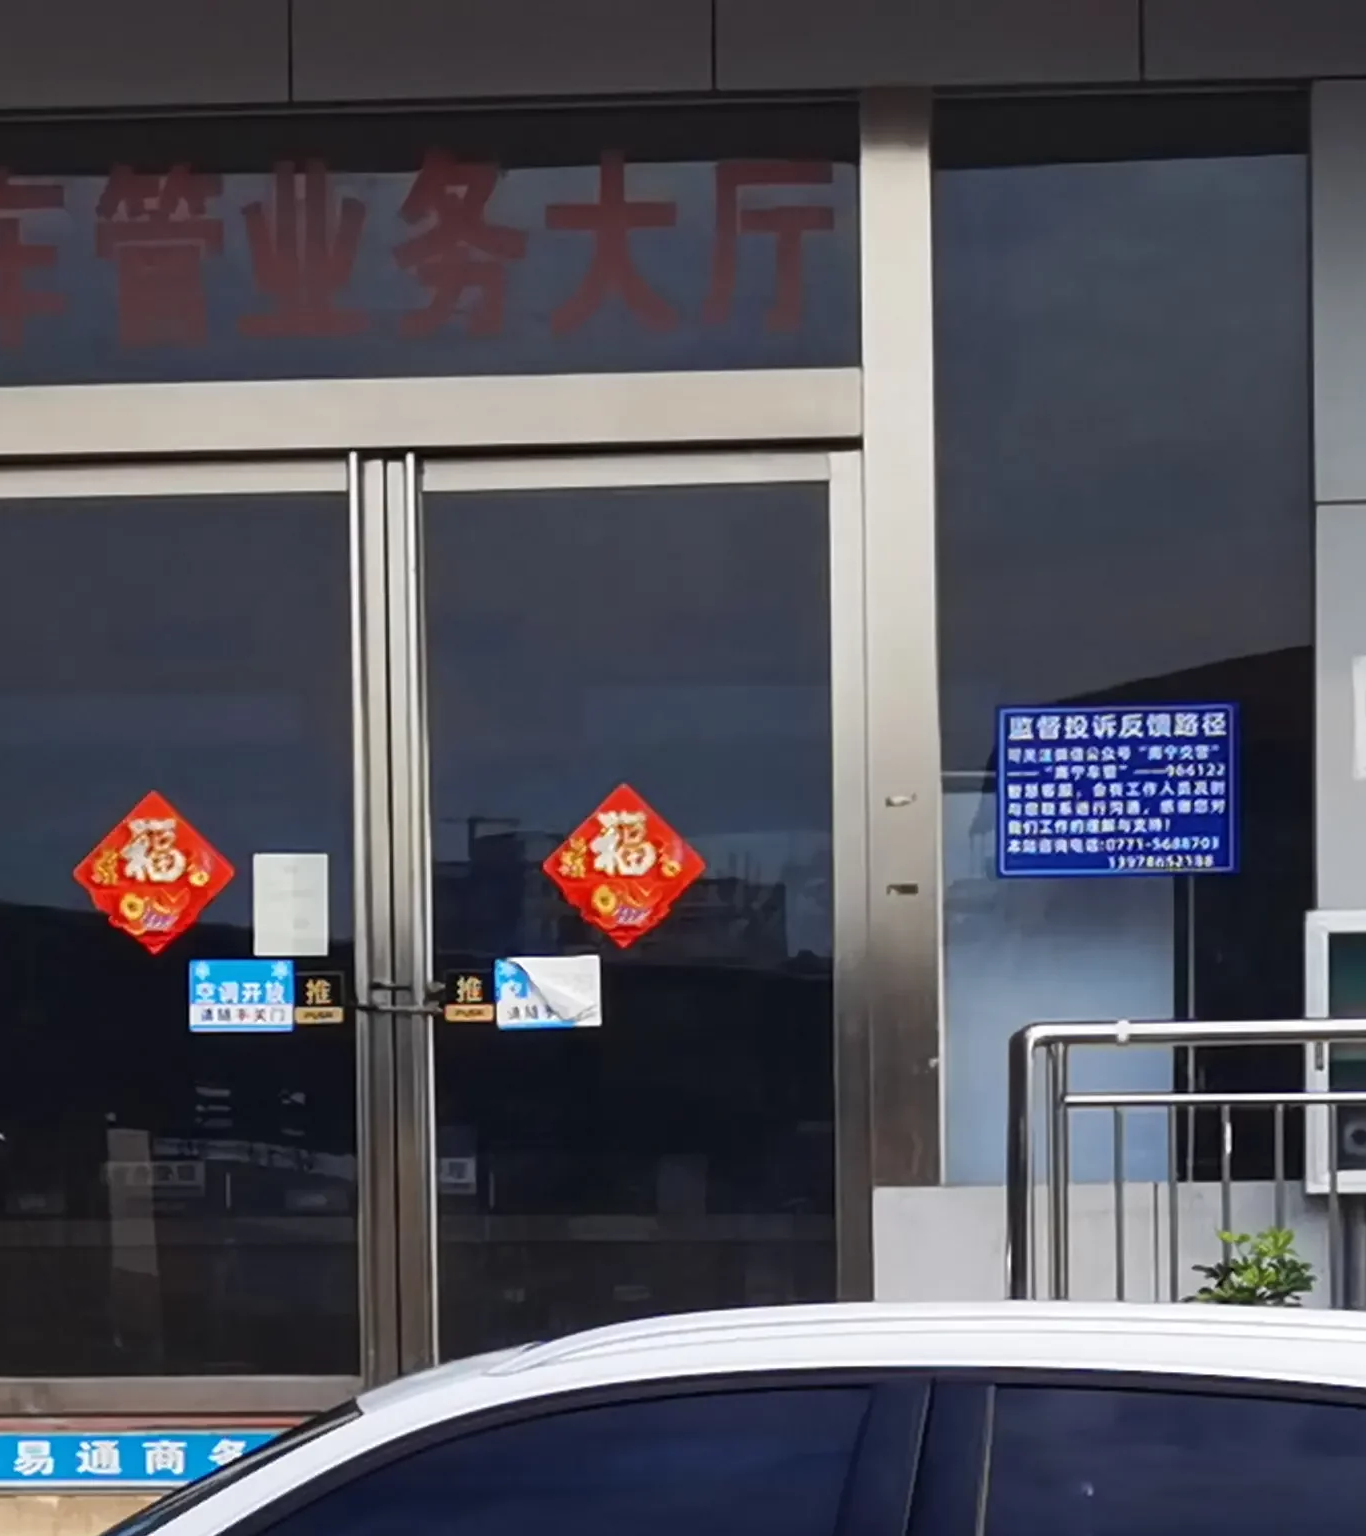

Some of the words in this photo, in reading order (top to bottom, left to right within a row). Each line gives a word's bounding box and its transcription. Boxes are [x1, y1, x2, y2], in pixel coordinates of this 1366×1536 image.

[1008, 712, 1227, 740] 监督投诉反馈路径
[120, 818, 187, 883] 福
[590, 810, 657, 877] 福
[195, 981, 285, 1004] 空调开放
[304, 977, 332, 1005] 推
[456, 975, 483, 1003] 推
[201, 1008, 285, 1022] 请随手关门
